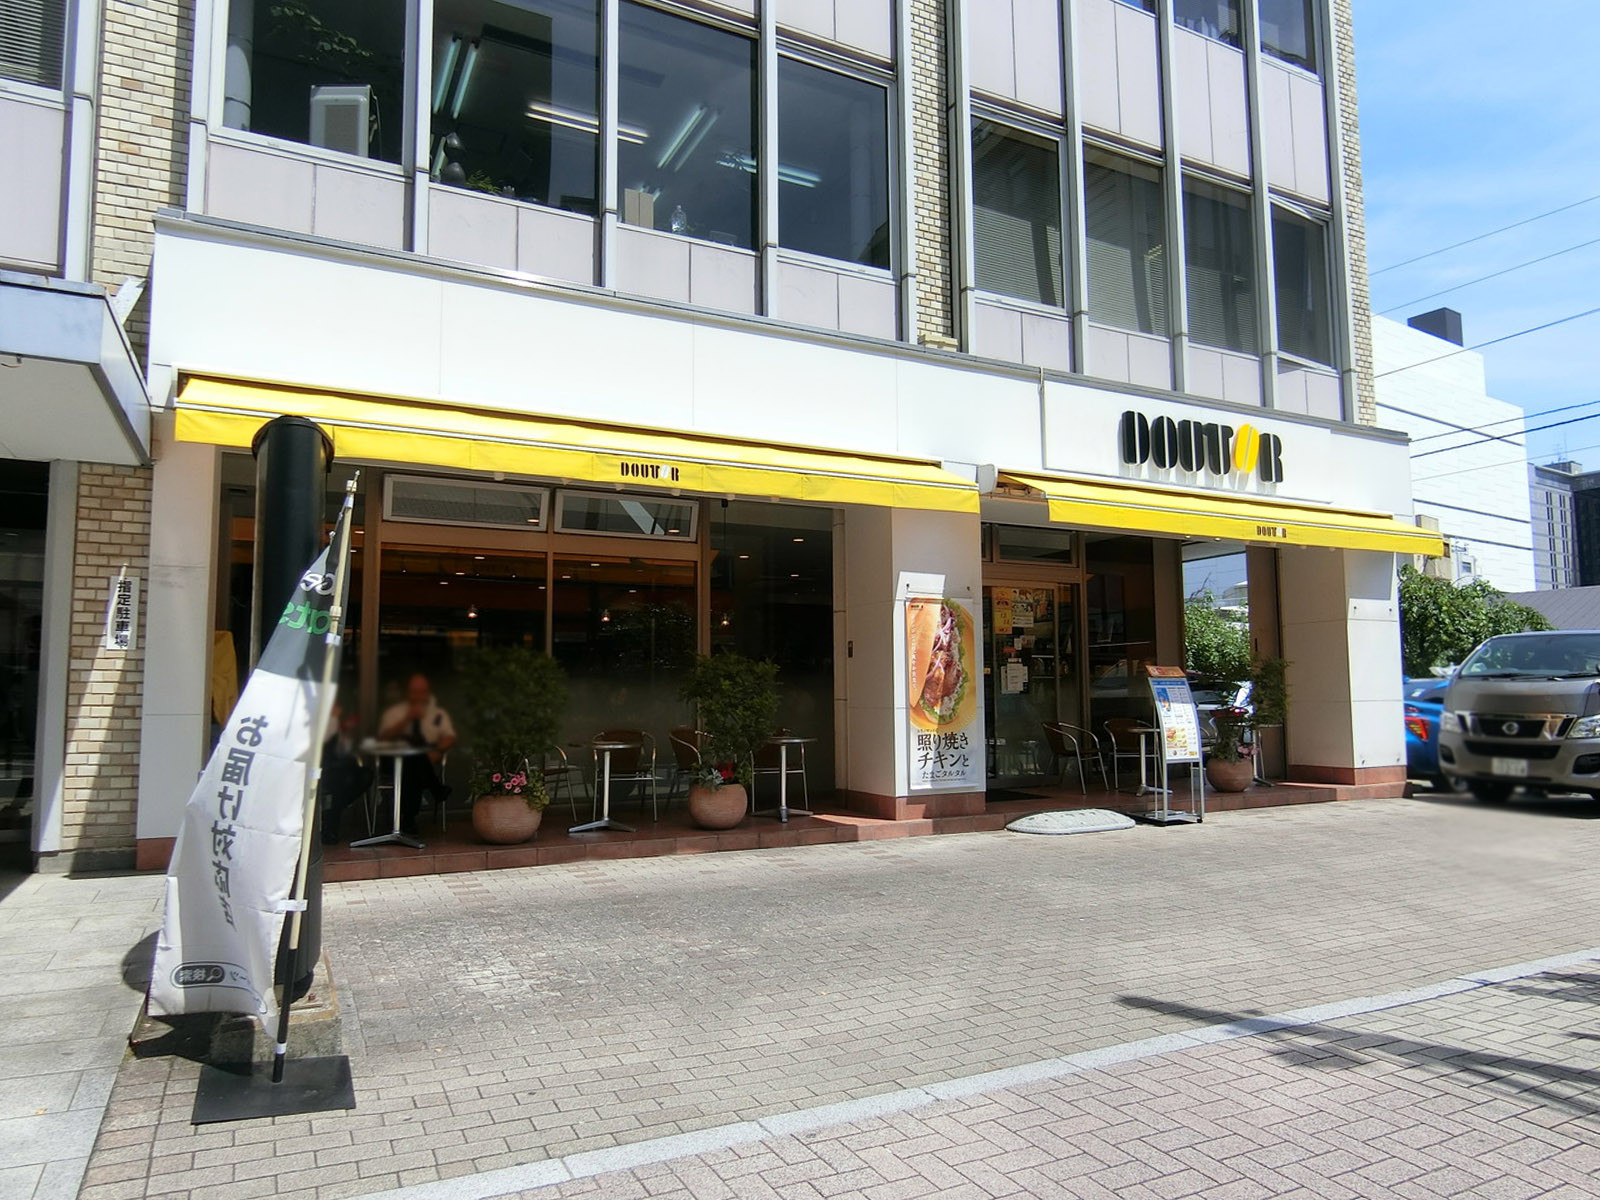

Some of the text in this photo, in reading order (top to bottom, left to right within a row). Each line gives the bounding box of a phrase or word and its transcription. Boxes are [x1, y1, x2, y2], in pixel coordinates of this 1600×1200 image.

[1121, 410, 1284, 483] DOUTOR
[620, 462, 680, 482] DOUTOR
[113, 580, 132, 649] 指定駐車場
[917, 731, 969, 752] 照り焼き
[917, 751, 970, 771] チキンと
[921, 769, 967, 780] たまごタルタル
